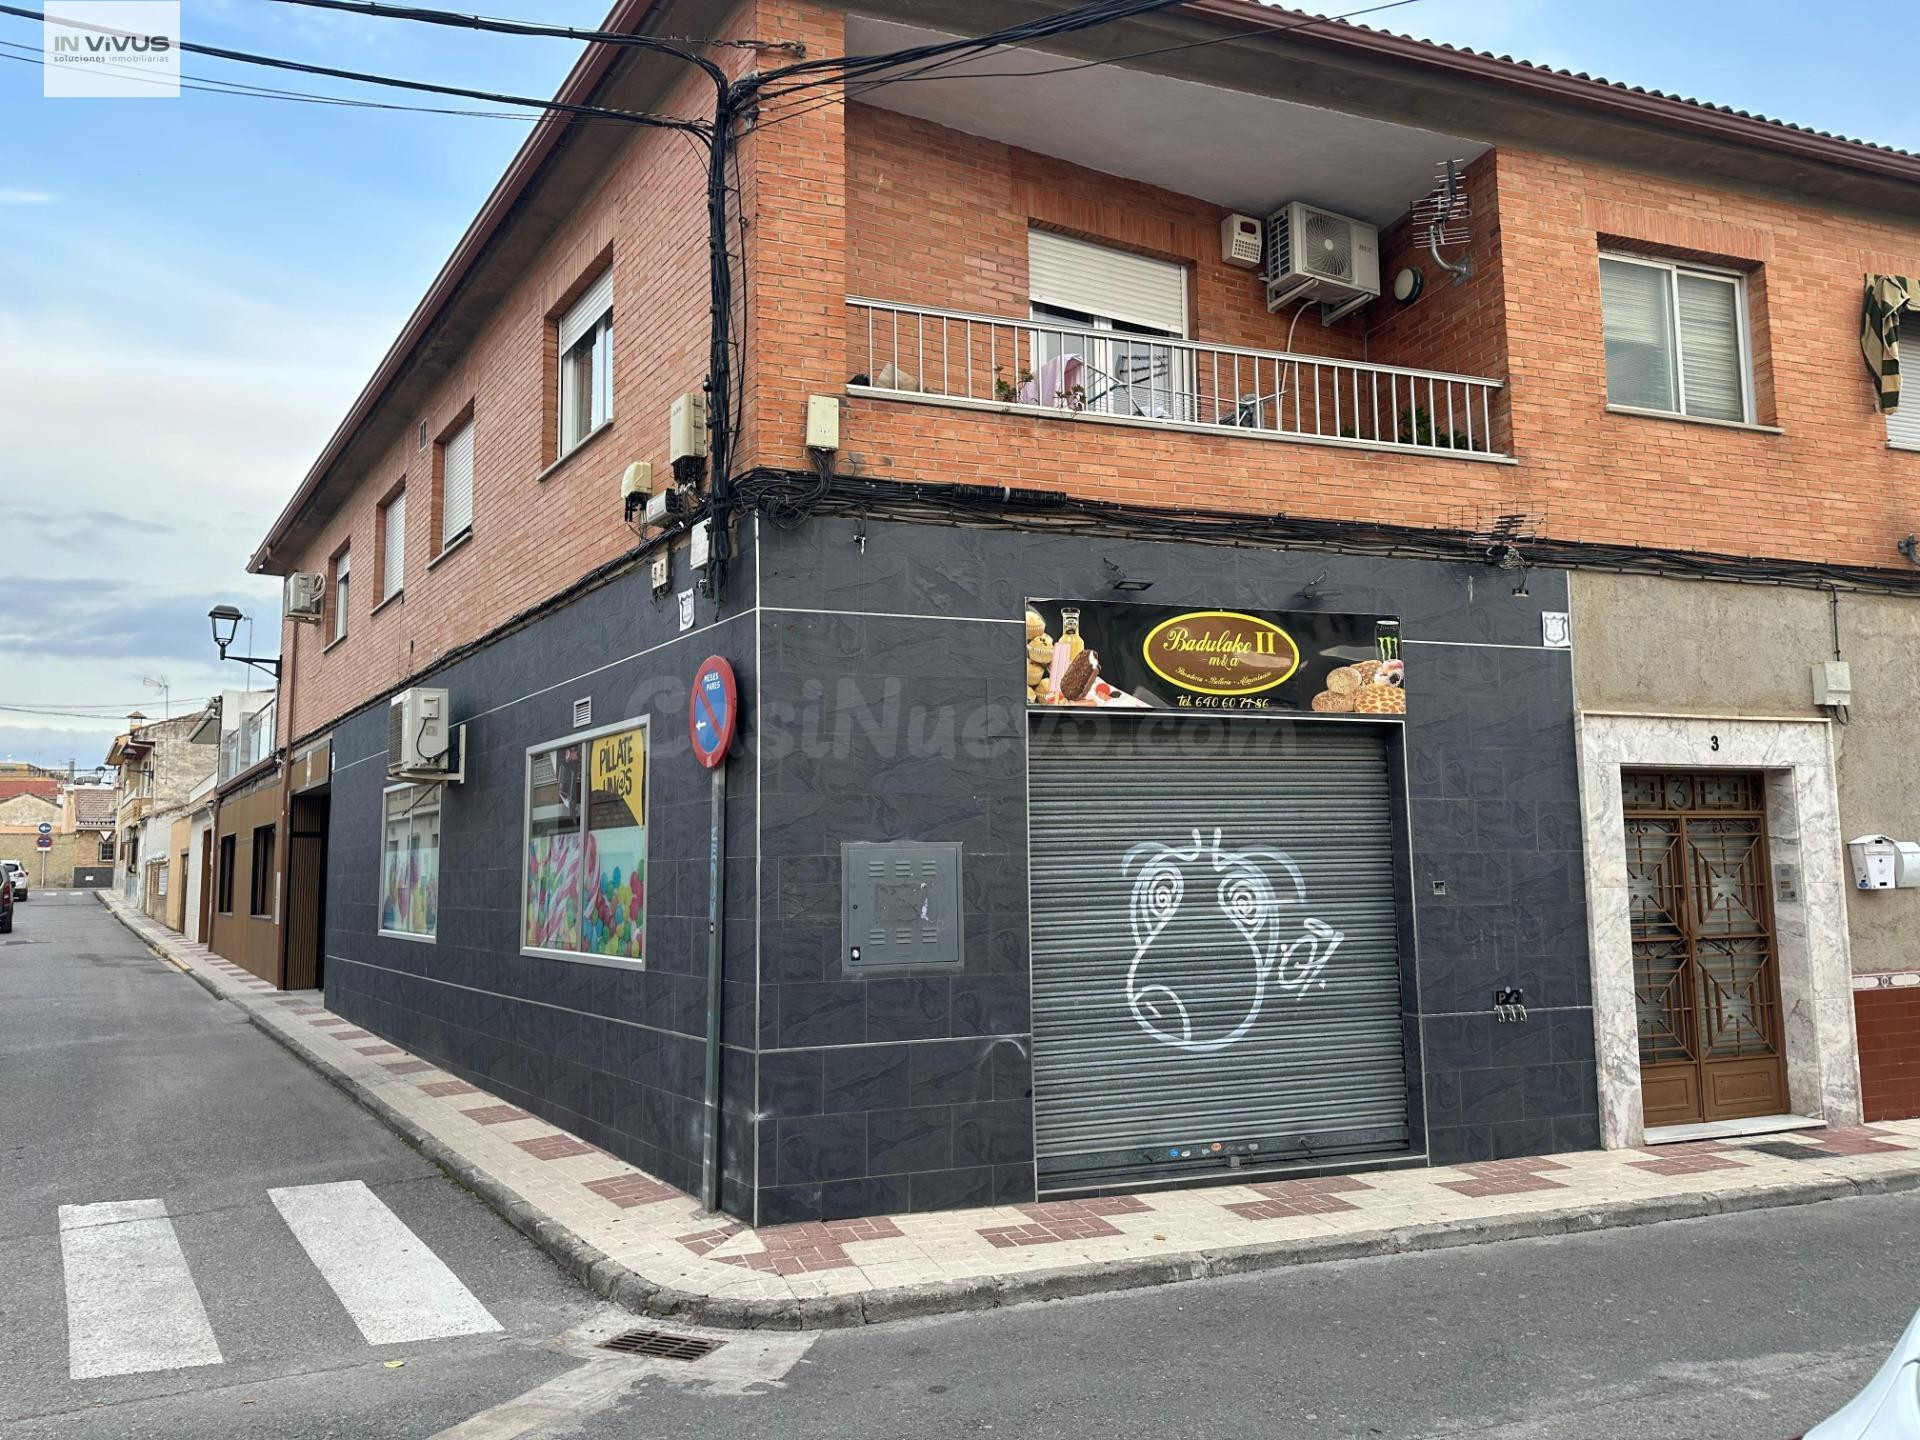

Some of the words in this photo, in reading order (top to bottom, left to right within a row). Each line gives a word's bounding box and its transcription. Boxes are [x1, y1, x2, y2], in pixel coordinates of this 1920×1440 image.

[1163, 627, 1252, 654] Badulake
[1255, 631, 1276, 655] II
[704, 672, 719, 682] MESES
[706, 681, 720, 691] PARES
[1195, 696, 1219, 708] 640
[1221, 698, 1236, 711] 60
[1711, 735, 1719, 752] 3
[1671, 777, 1686, 808] 3
